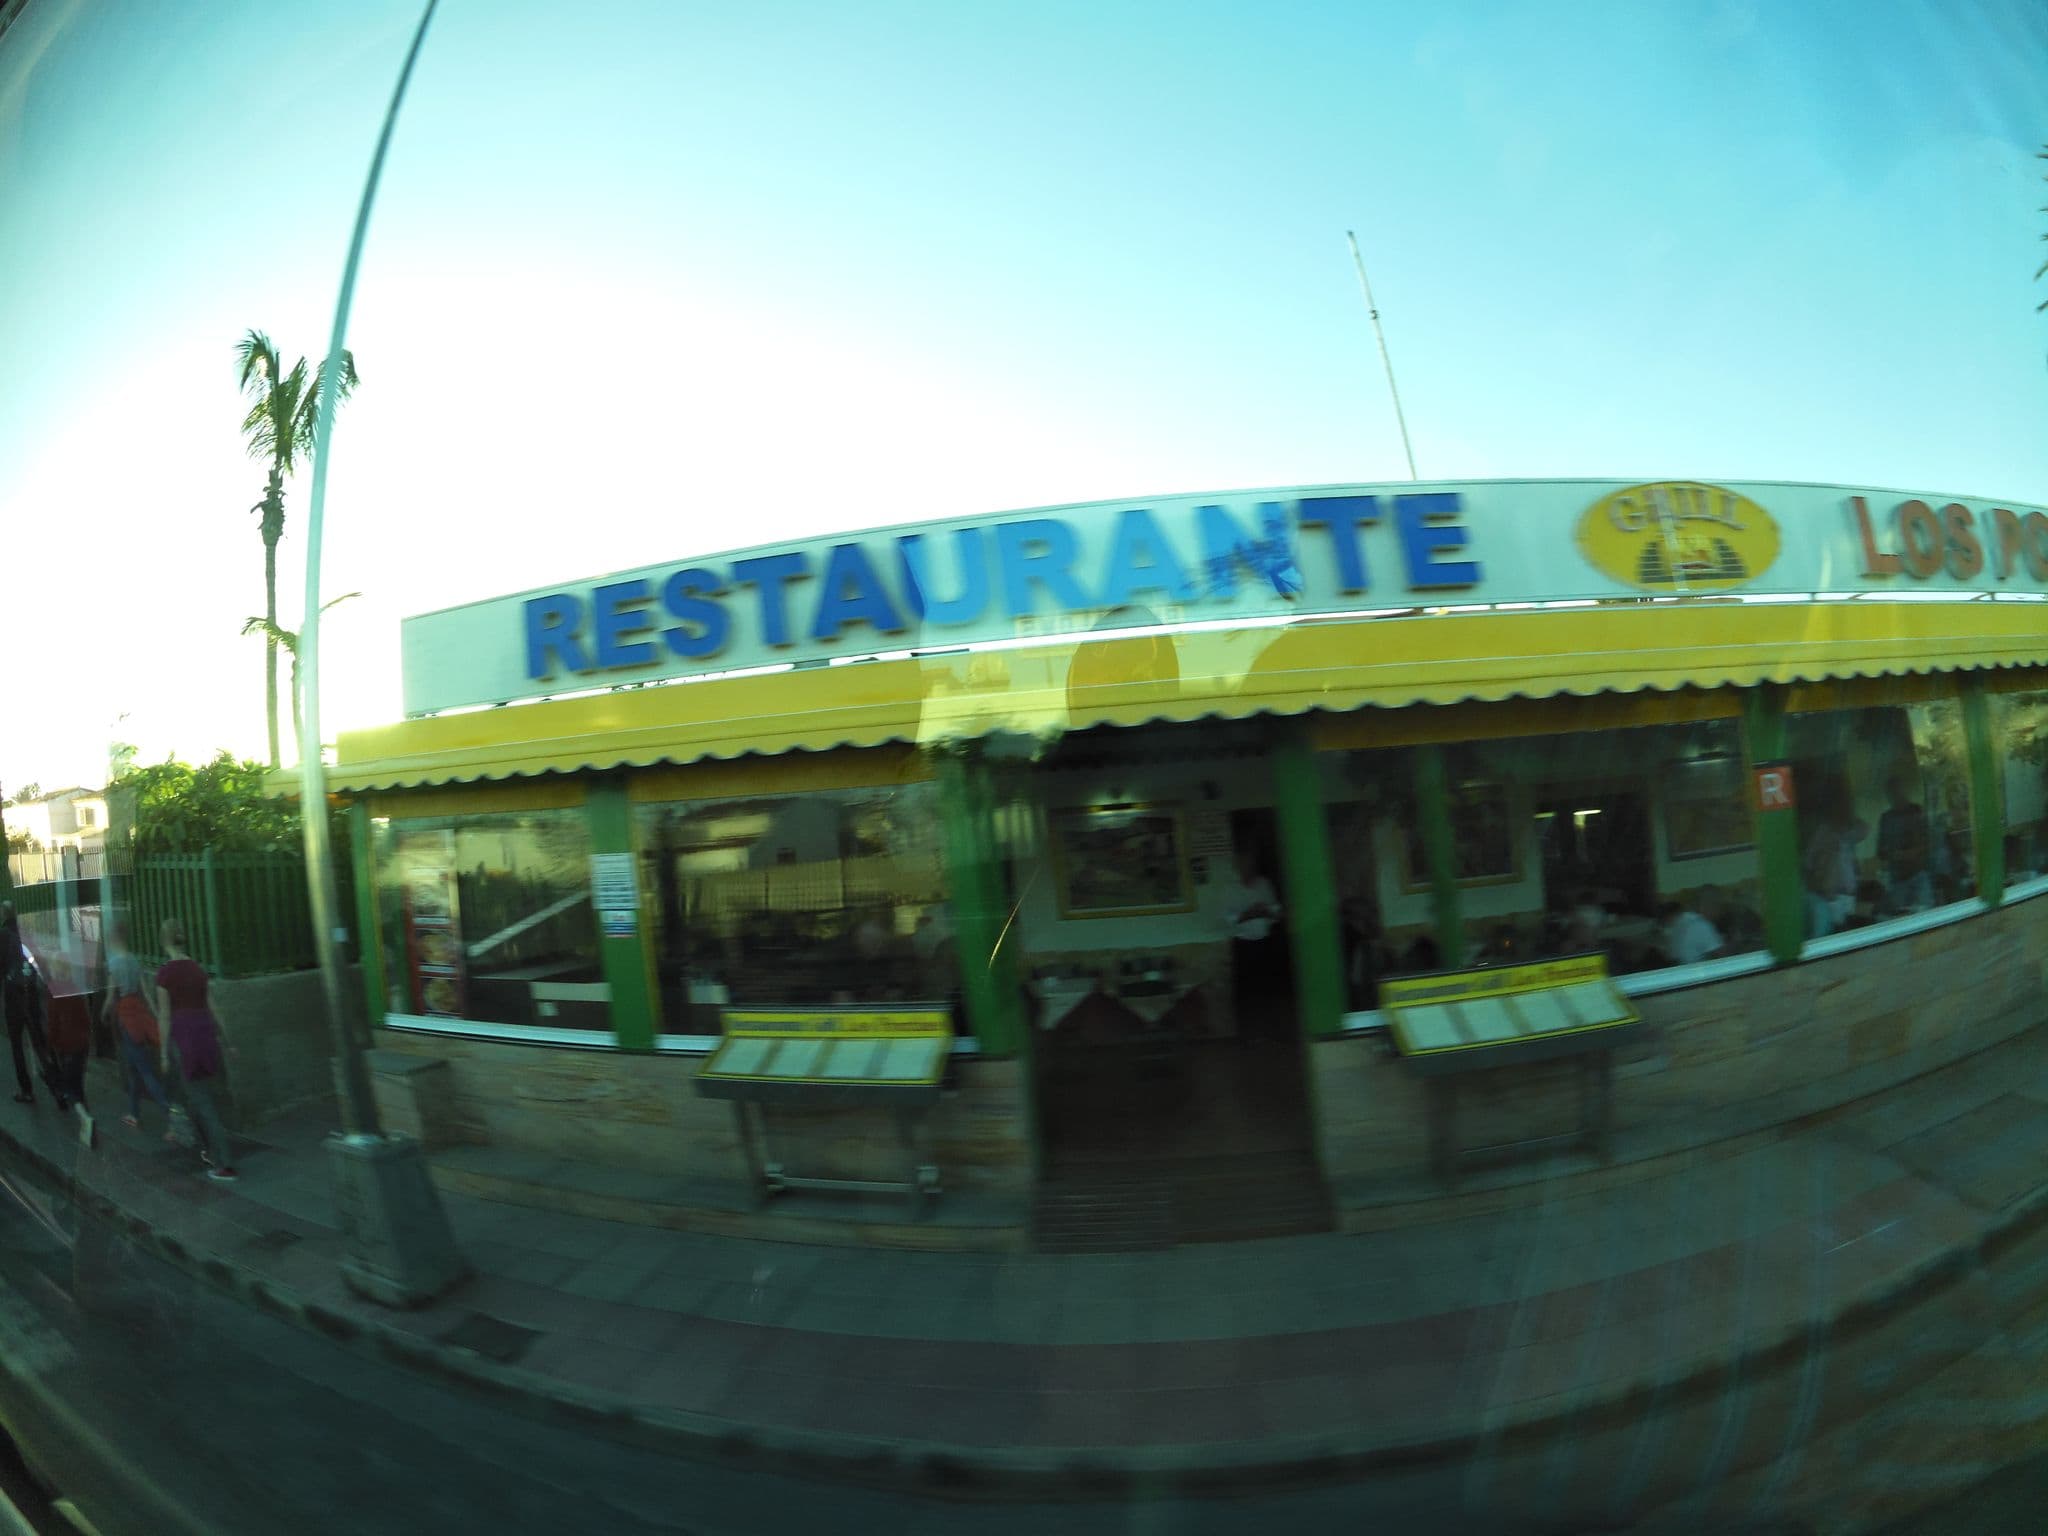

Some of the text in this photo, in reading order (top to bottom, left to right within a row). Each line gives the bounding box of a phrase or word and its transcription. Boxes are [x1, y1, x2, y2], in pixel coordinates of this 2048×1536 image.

[1846, 496, 1985, 580] LOS
[523, 492, 1482, 681] RESTAURANTE
[1760, 773, 1790, 806] R
